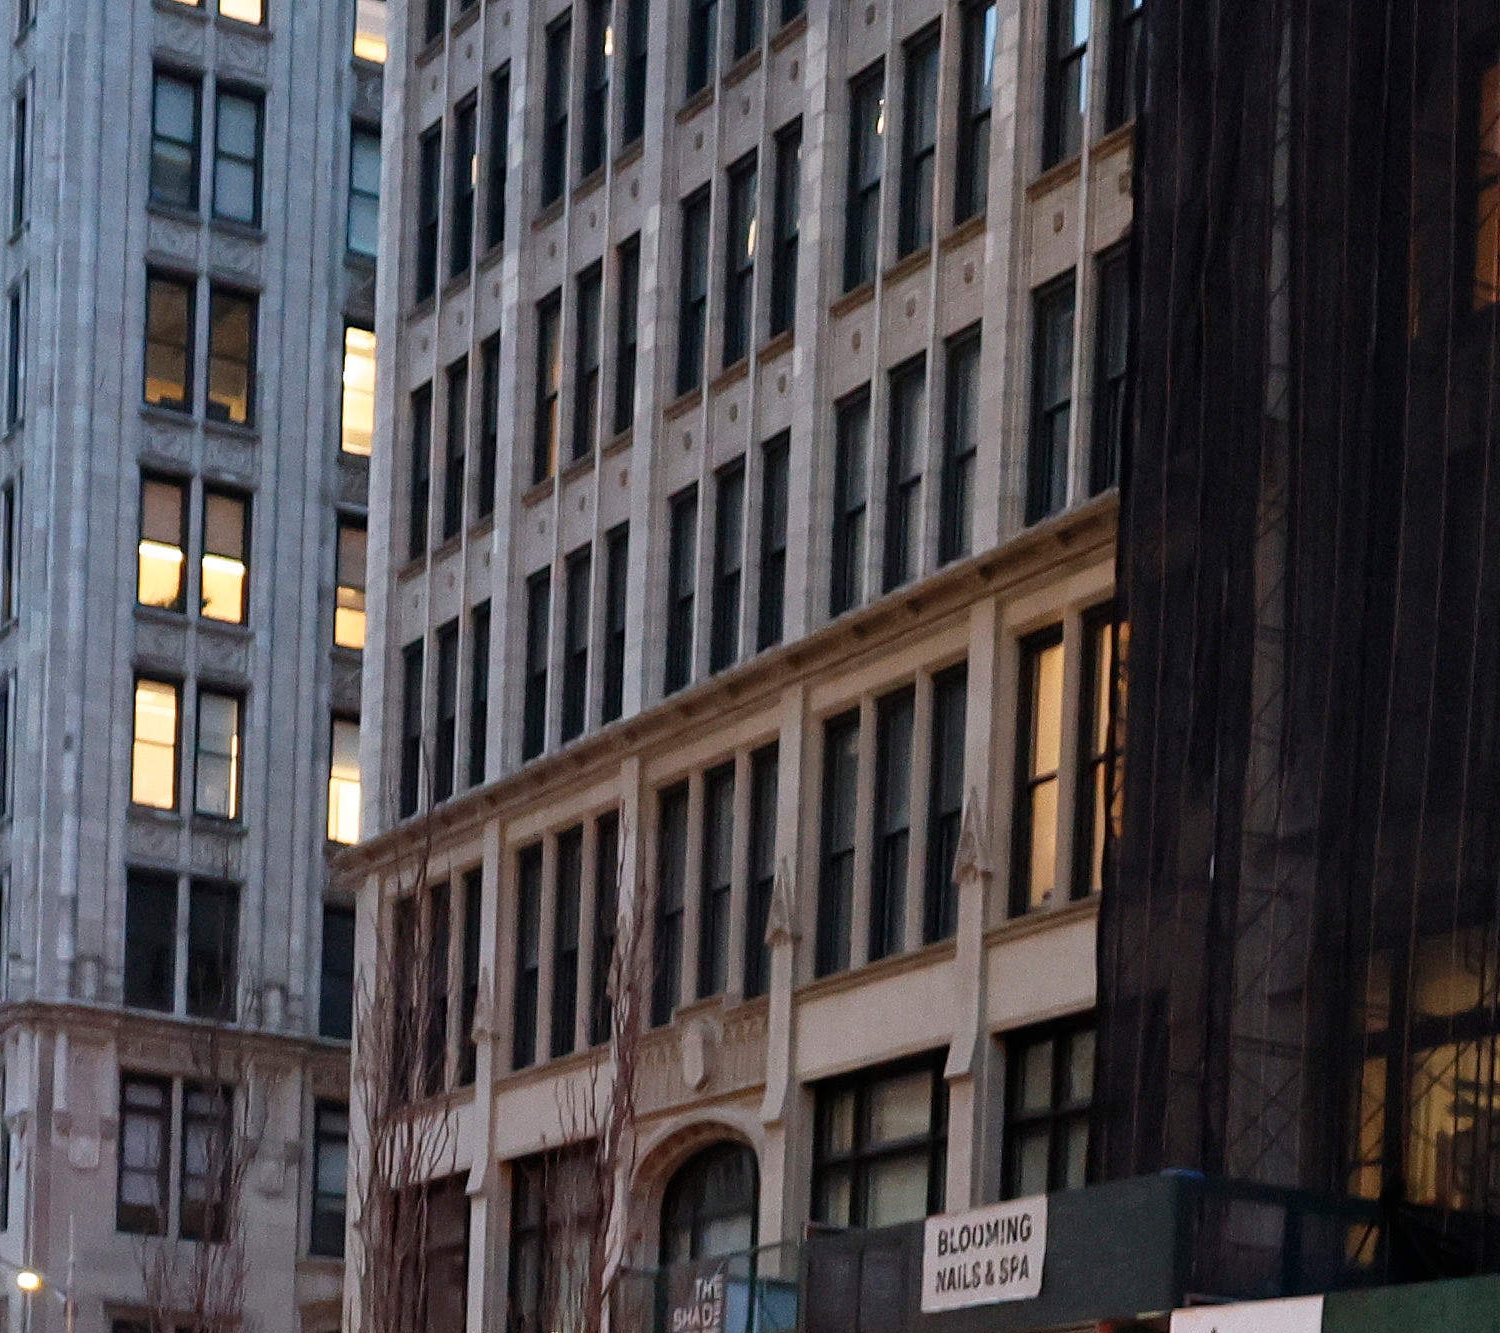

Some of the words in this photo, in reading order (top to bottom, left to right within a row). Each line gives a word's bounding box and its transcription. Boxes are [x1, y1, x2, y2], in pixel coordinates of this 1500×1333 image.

[937, 1212, 1033, 1257] BLOOMING
[935, 1260, 981, 1293] NAILS
[984, 1261, 995, 1285] &
[999, 1253, 1030, 1284] SPA
[672, 1302, 722, 1331] SHADE
